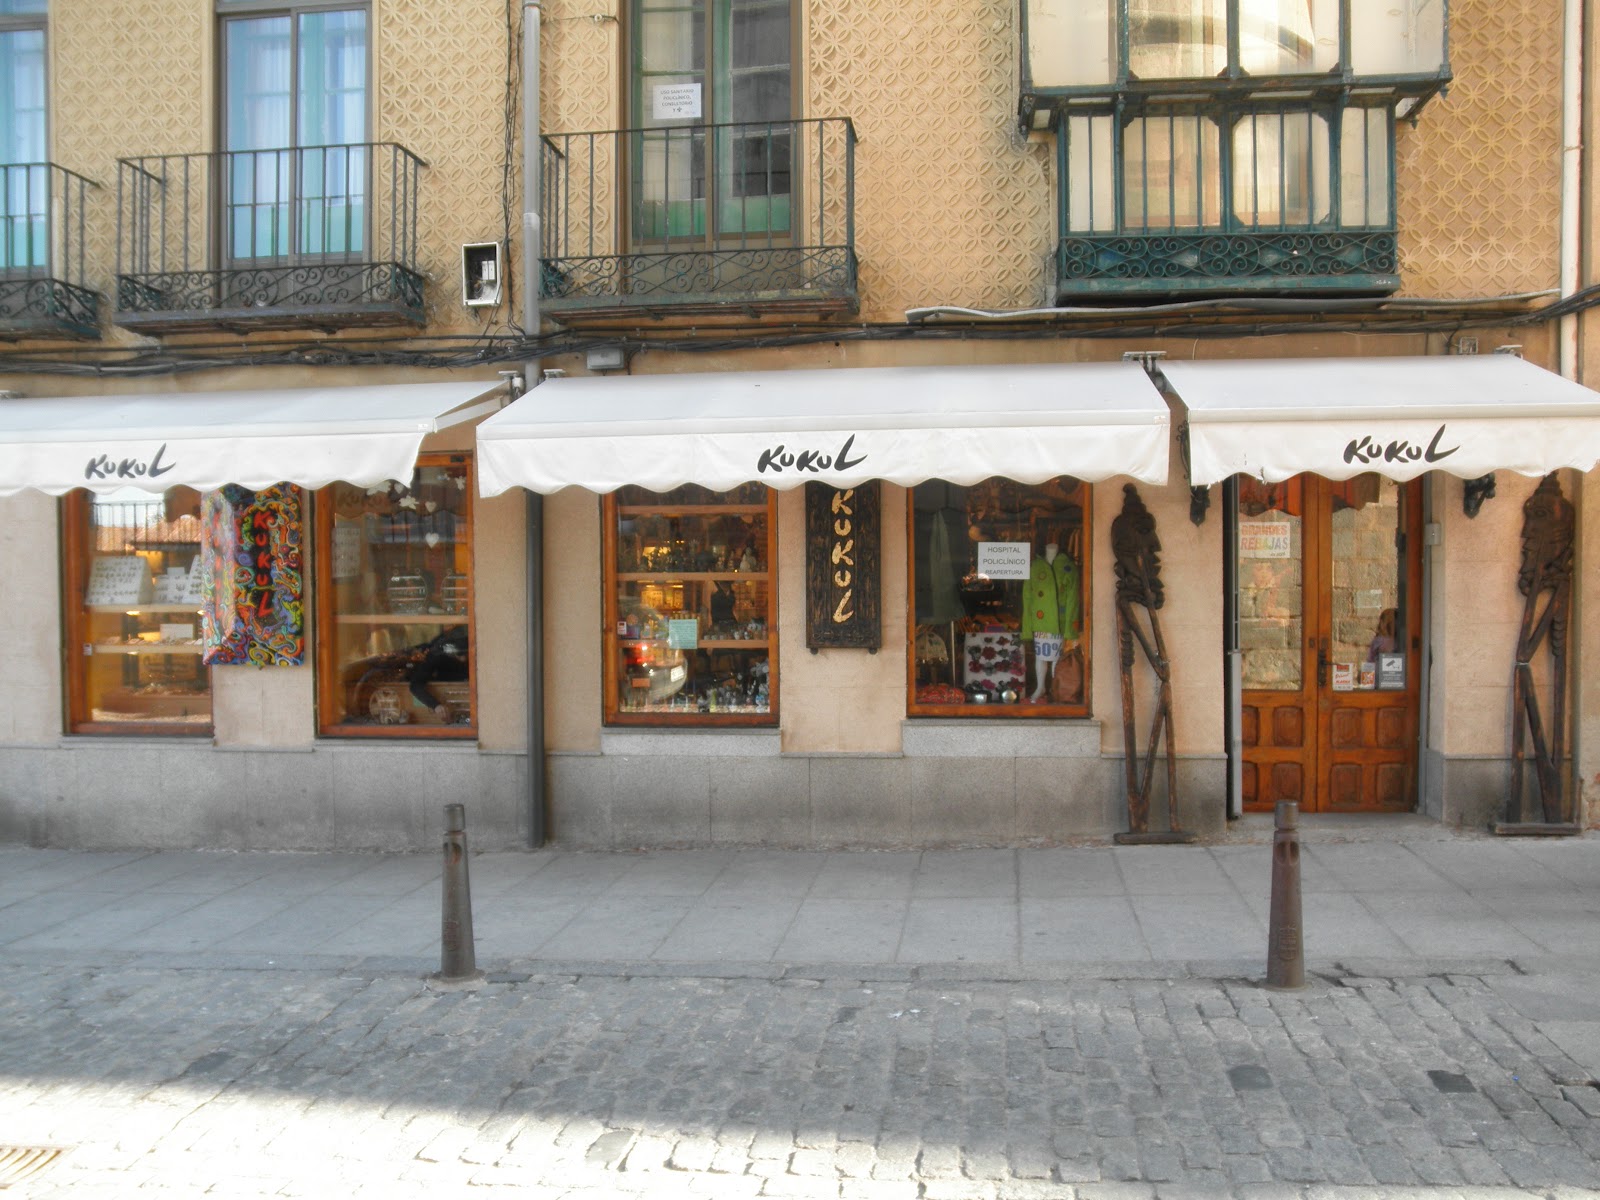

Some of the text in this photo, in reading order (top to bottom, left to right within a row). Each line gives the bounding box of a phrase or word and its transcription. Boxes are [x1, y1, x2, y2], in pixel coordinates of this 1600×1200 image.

[84, 442, 177, 480] KUKUL
[757, 433, 868, 474] KUKUL
[1343, 423, 1461, 464] KUKUL
[254, 511, 274, 617] KUKUL
[831, 489, 854, 623] KUKUL
[1241, 537, 1288, 550] REBAJAS
[1035, 641, 1063, 657] 50%
